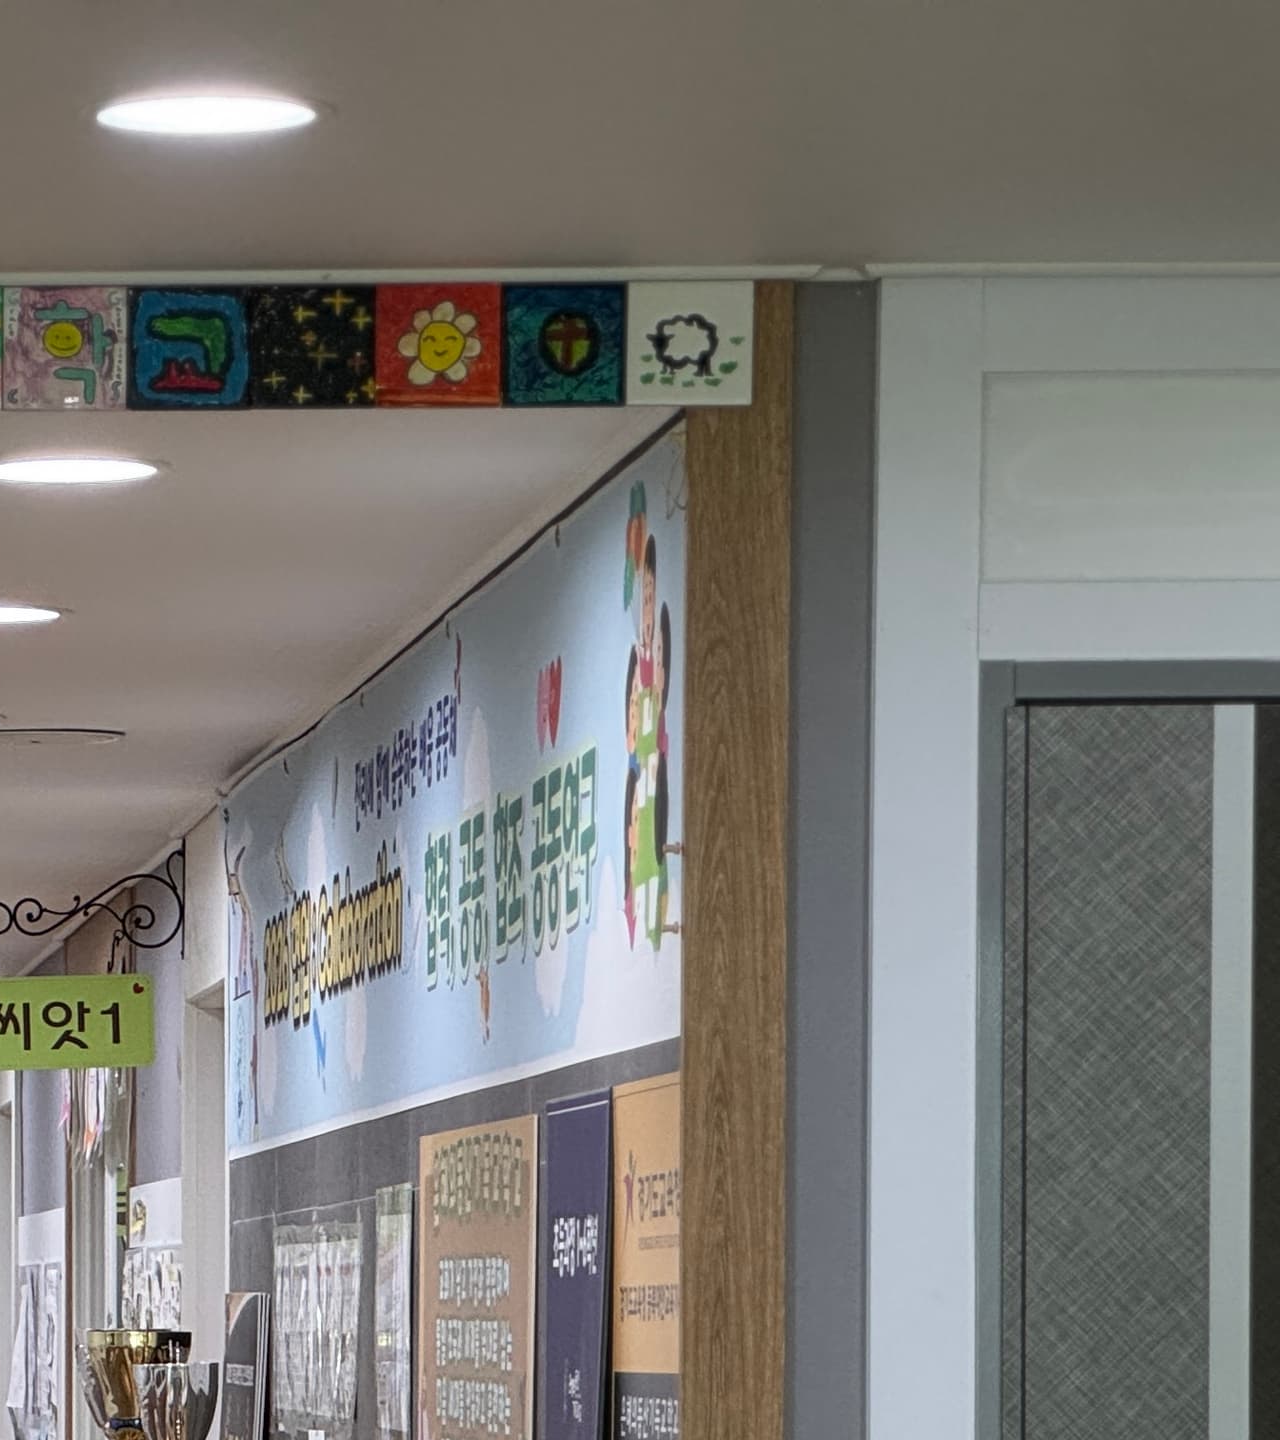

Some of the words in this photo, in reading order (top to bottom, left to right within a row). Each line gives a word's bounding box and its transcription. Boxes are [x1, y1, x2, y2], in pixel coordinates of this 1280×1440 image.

[391, 719, 417, 811] 순종하는
[436, 694, 457, 782] 공동체
[264, 908, 289, 1029] 2026
[319, 840, 403, 1003] Collaboration
[425, 832, 453, 985] 협력,
[531, 747, 597, 945] 공동연구
